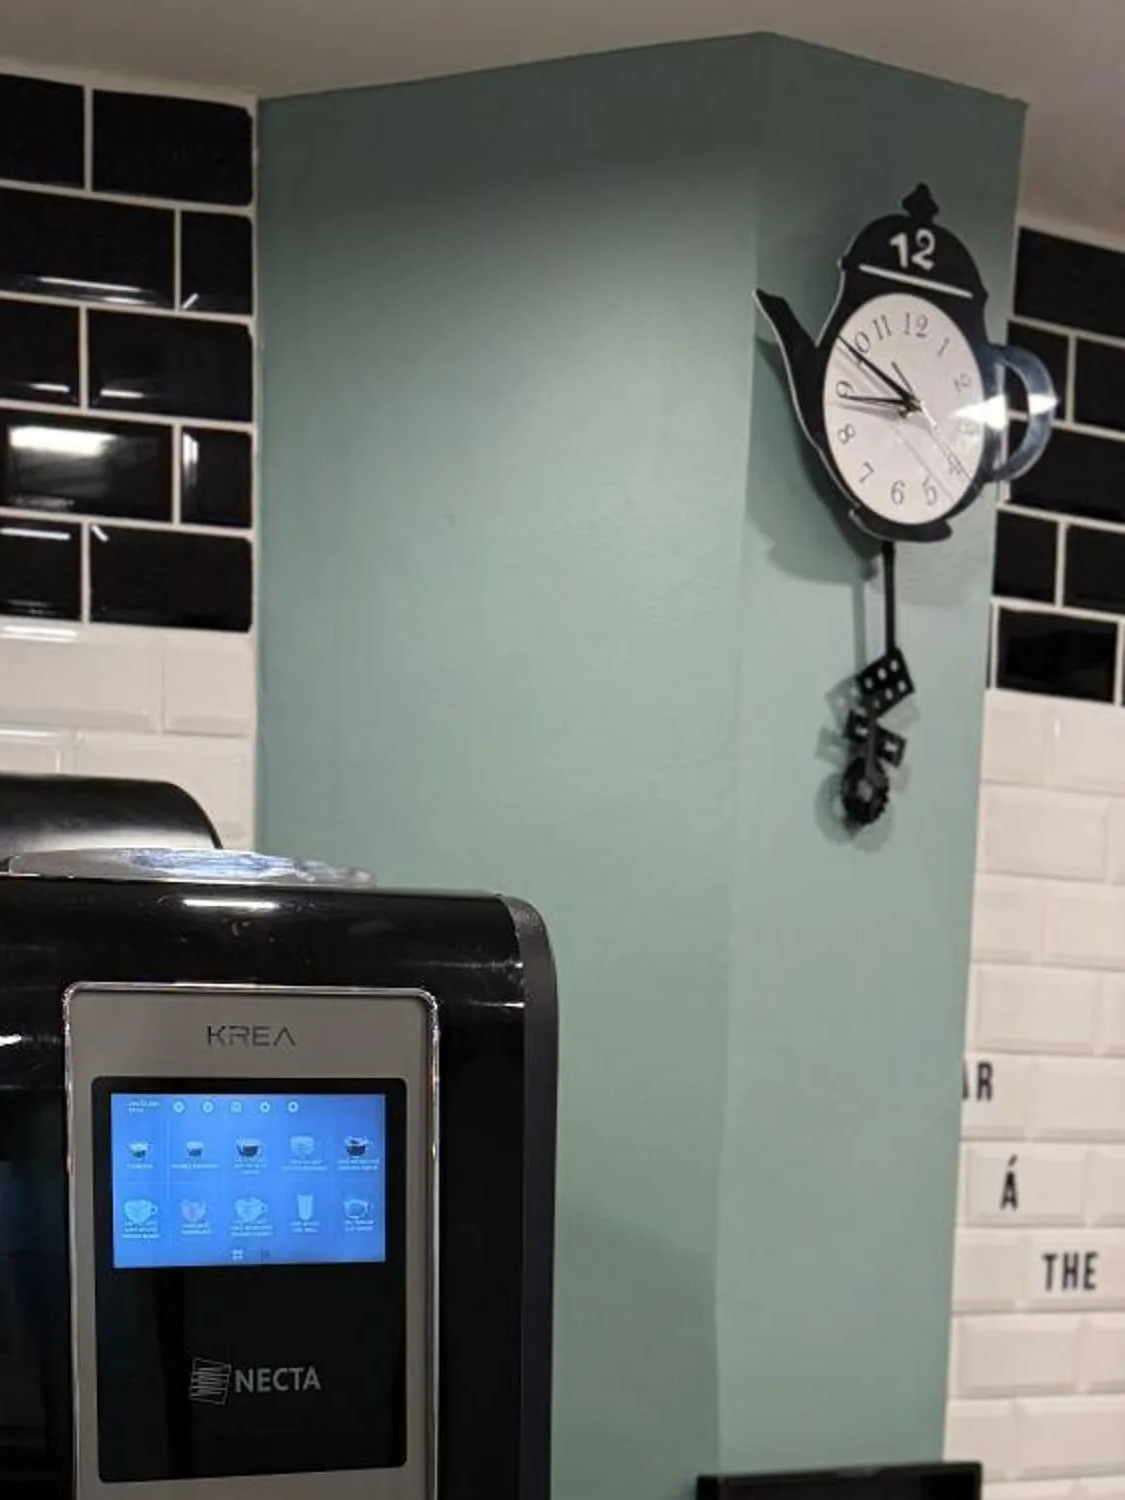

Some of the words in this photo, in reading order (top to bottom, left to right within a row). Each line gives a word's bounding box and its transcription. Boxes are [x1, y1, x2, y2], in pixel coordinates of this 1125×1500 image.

[889, 228, 936, 270] 12
[872, 314, 892, 341] 11
[903, 311, 929, 338] 12
[937, 337, 950, 357] 1
[837, 423, 856, 444] 8
[858, 461, 874, 484] 7
[890, 479, 906, 505] 6
[923, 477, 938, 505] 5
[206, 1025, 297, 1048] KREA
[1041, 1251, 1099, 1292] THE
[234, 1366, 322, 1393] NECTA
